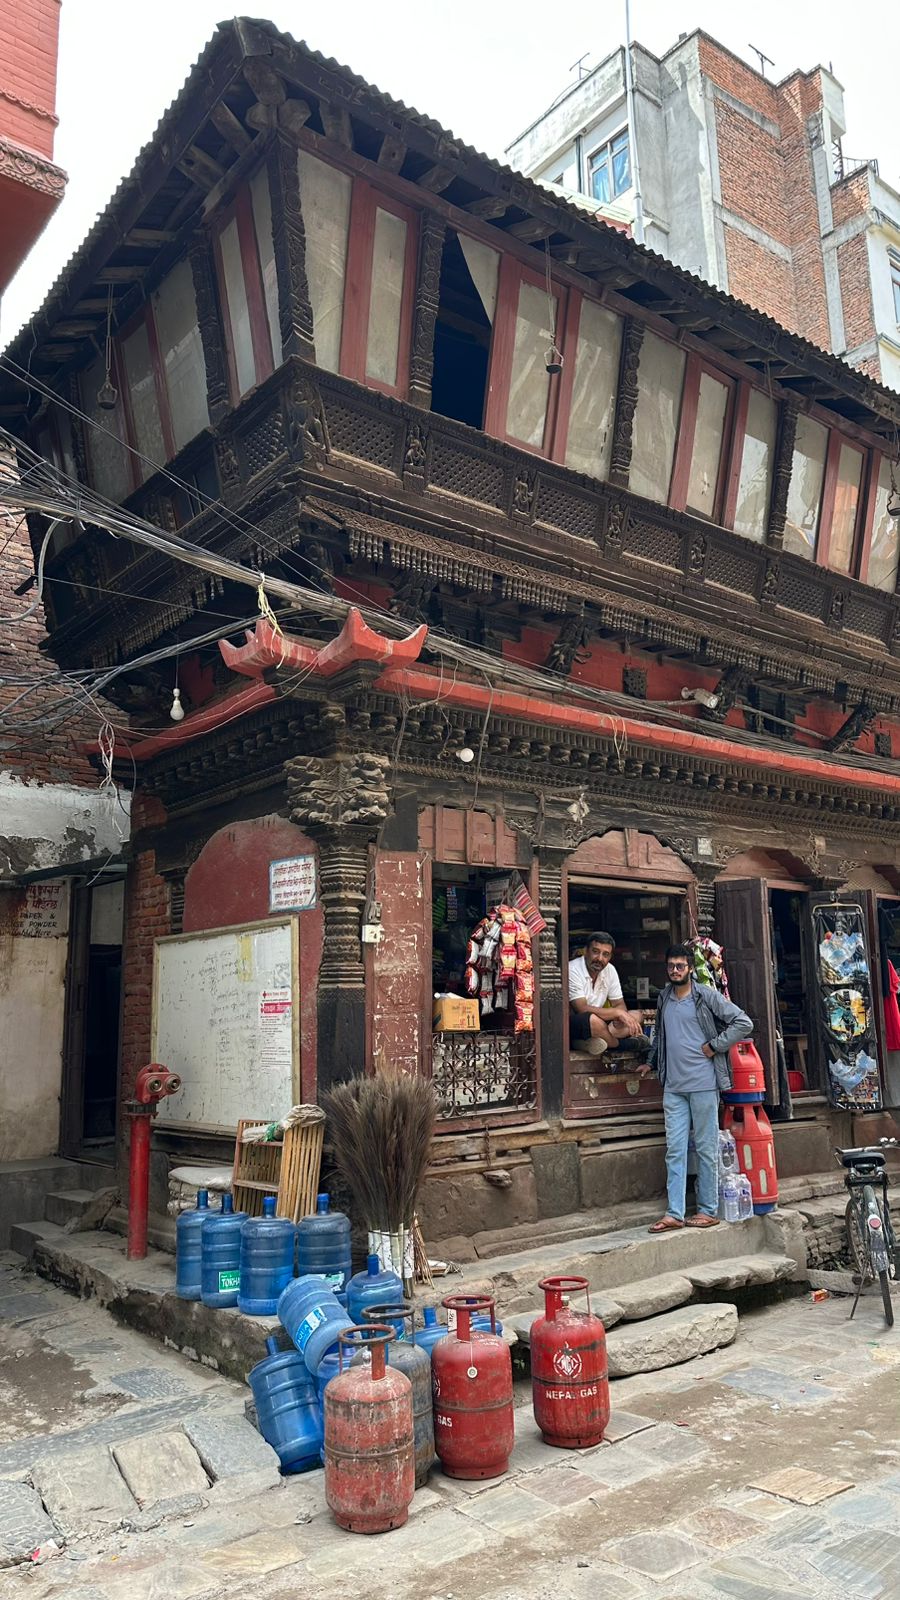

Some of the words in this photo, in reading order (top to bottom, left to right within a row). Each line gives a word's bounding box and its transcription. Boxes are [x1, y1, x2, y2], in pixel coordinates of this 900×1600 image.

[29, 920, 58, 928] POWDER
[580, 1386, 598, 1397] GAS
[438, 1415, 453, 1427] GAS
